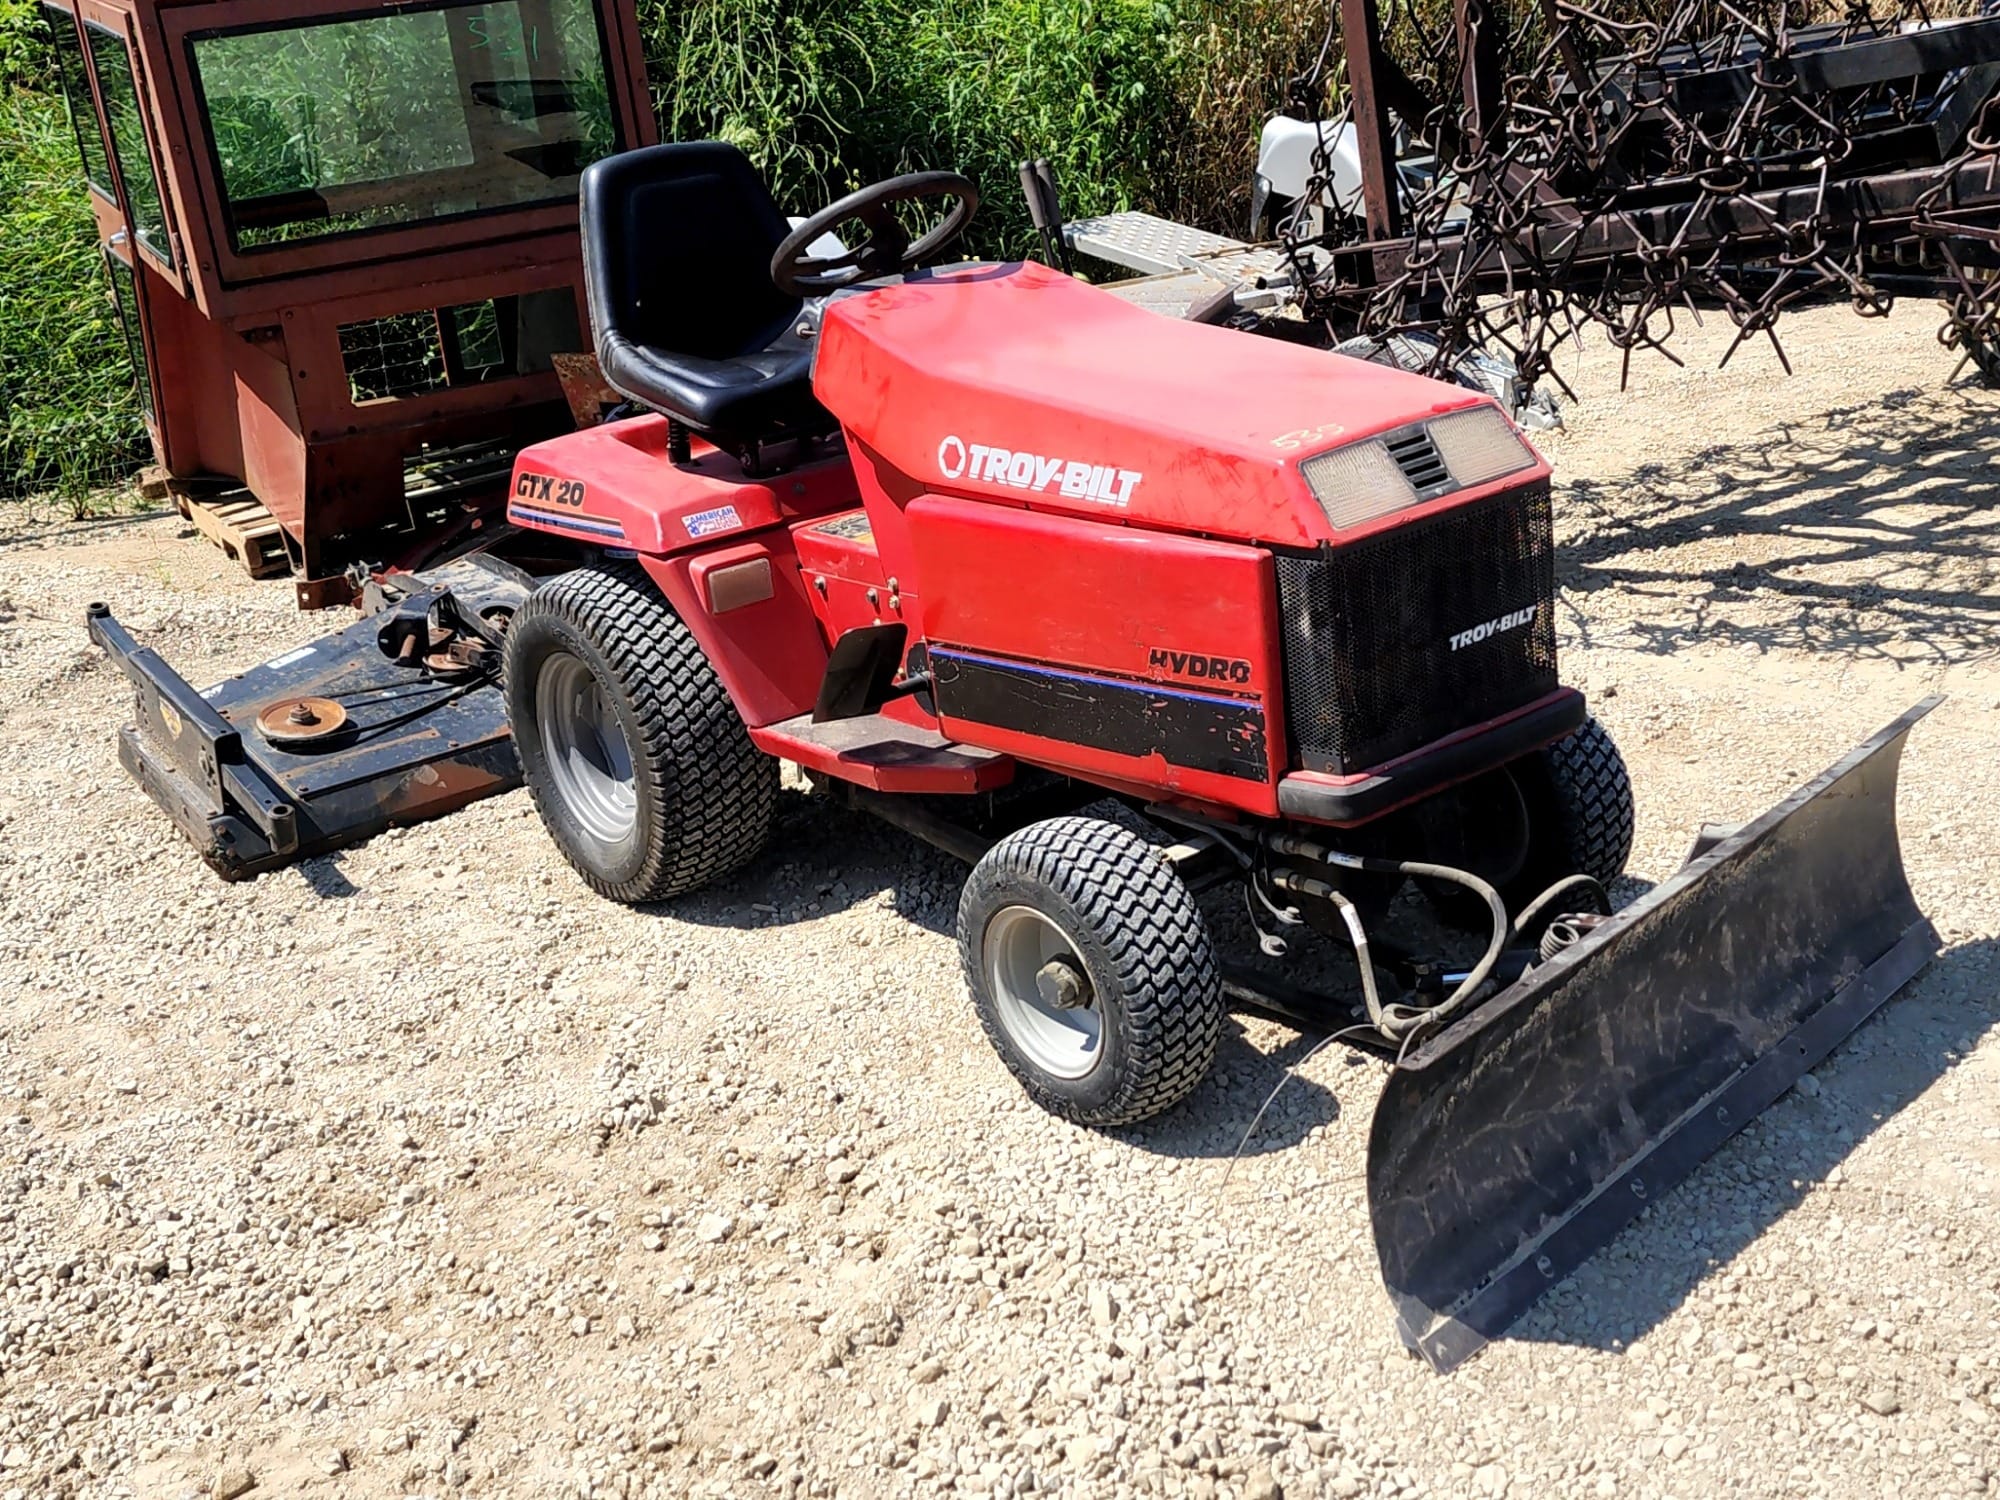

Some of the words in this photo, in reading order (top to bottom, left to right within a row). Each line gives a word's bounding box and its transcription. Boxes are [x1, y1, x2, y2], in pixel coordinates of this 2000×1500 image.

[517, 473, 555, 501] GTX
[556, 480, 585, 506] 20
[967, 444, 1142, 507] TROY-BILT
[690, 507, 734, 523] AMERICAN
[1449, 605, 1537, 651] TROY-BILT
[1150, 648, 1250, 684] HYDRO
